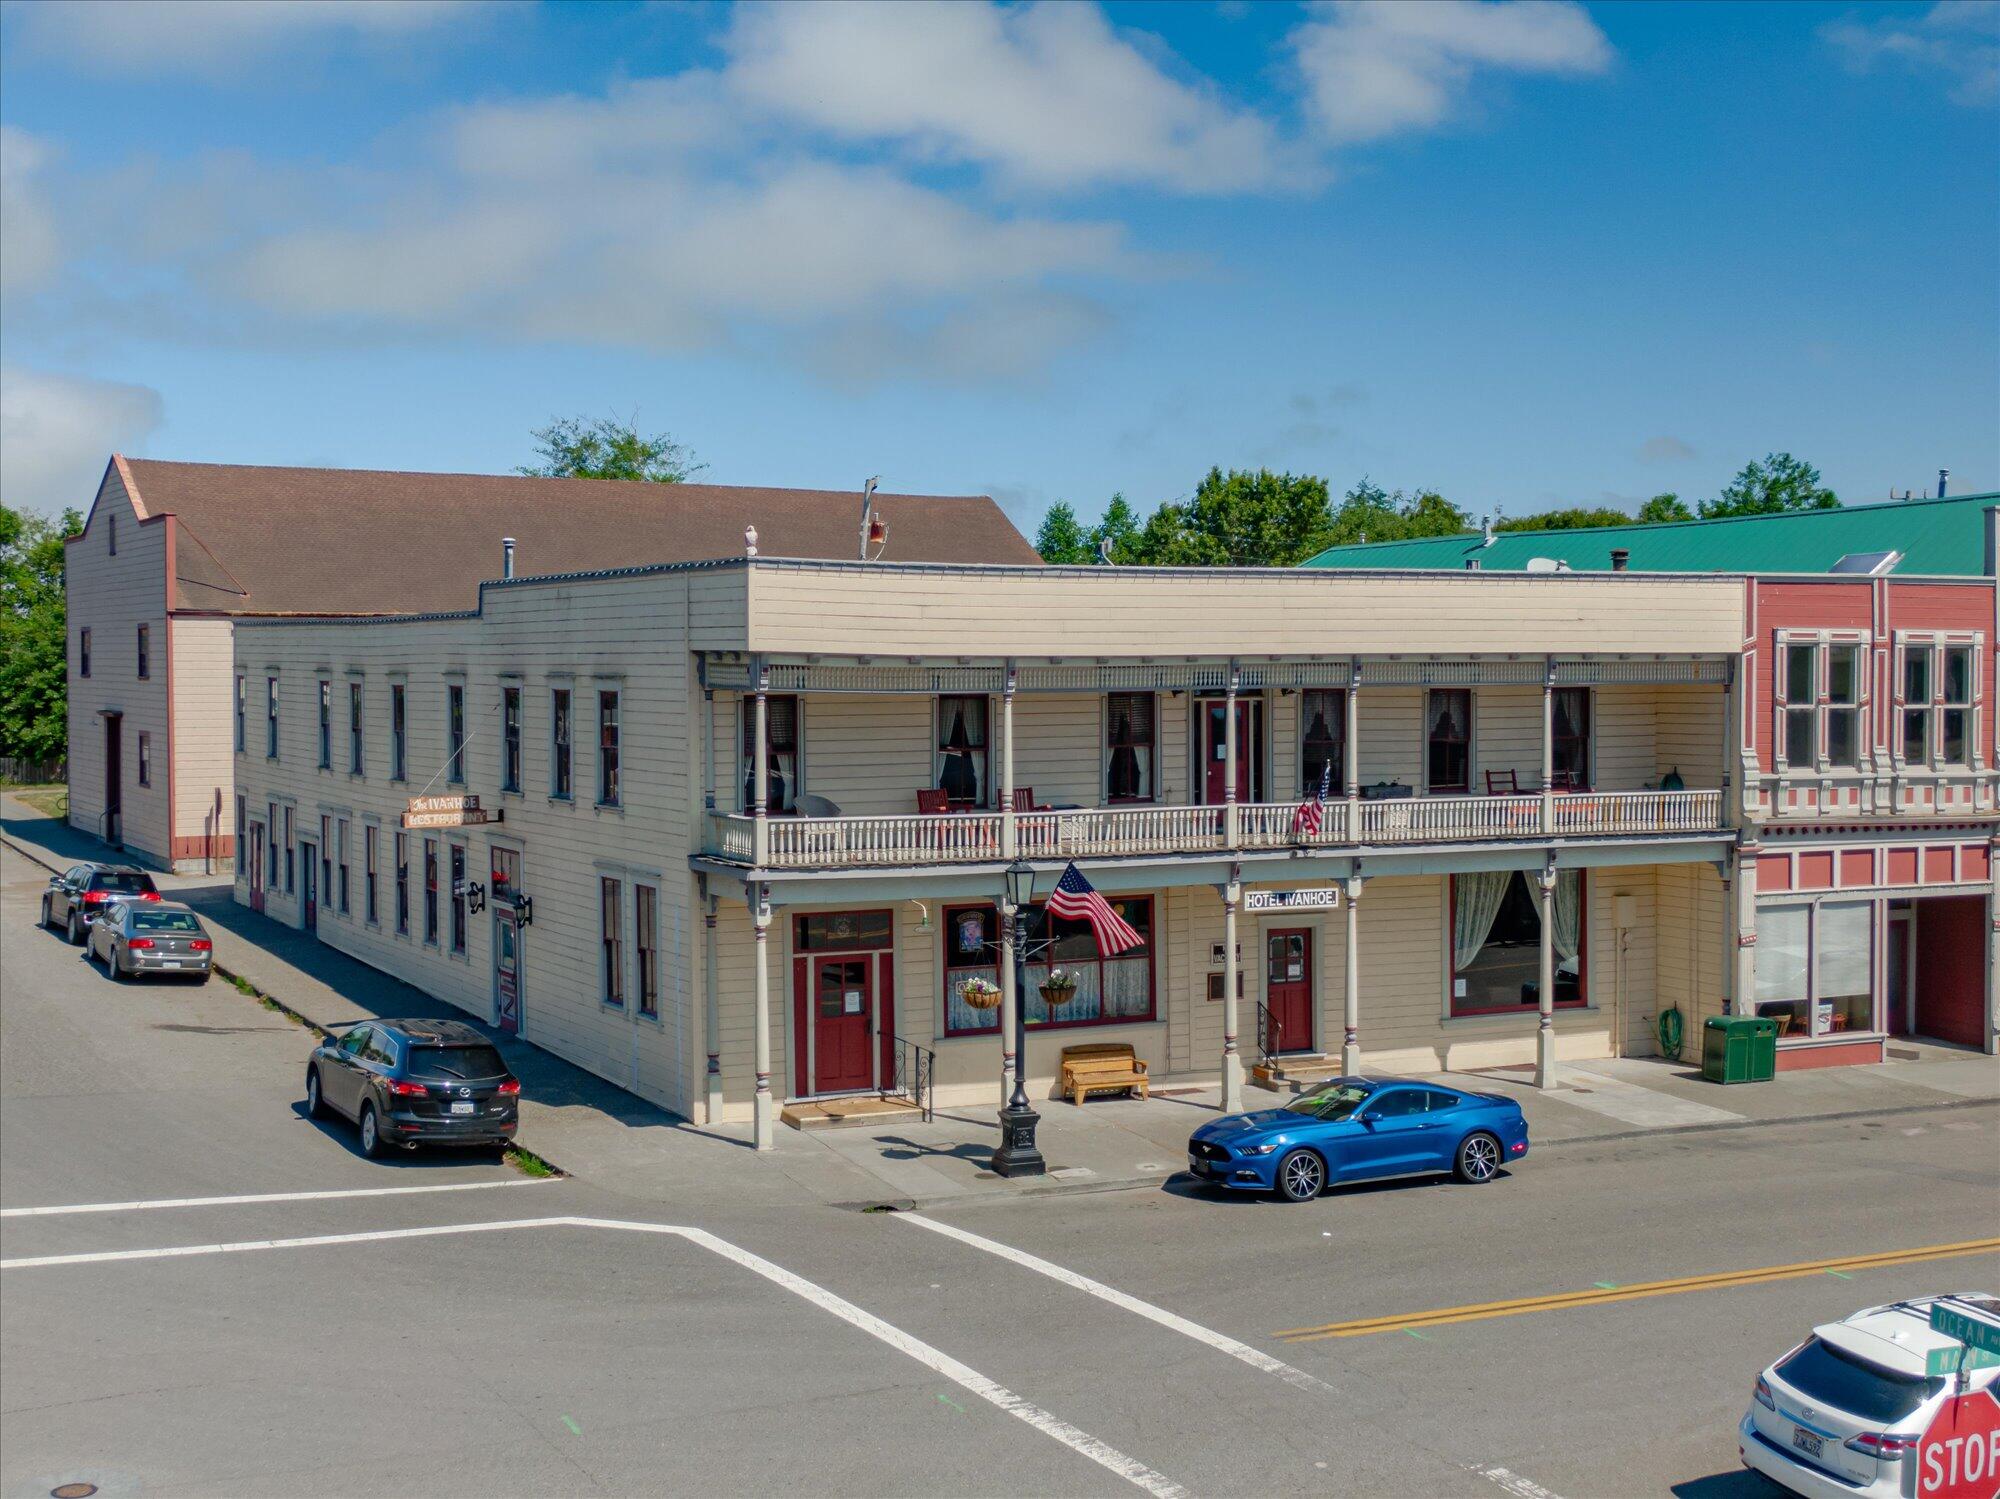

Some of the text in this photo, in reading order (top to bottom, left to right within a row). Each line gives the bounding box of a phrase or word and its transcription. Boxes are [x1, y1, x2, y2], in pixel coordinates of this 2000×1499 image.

[429, 797, 477, 810] IVANHOE
[1247, 894, 1283, 908] HOTEL
[1939, 1310, 1985, 1345] OCEAN
[1940, 1346, 1978, 1371] MAN
